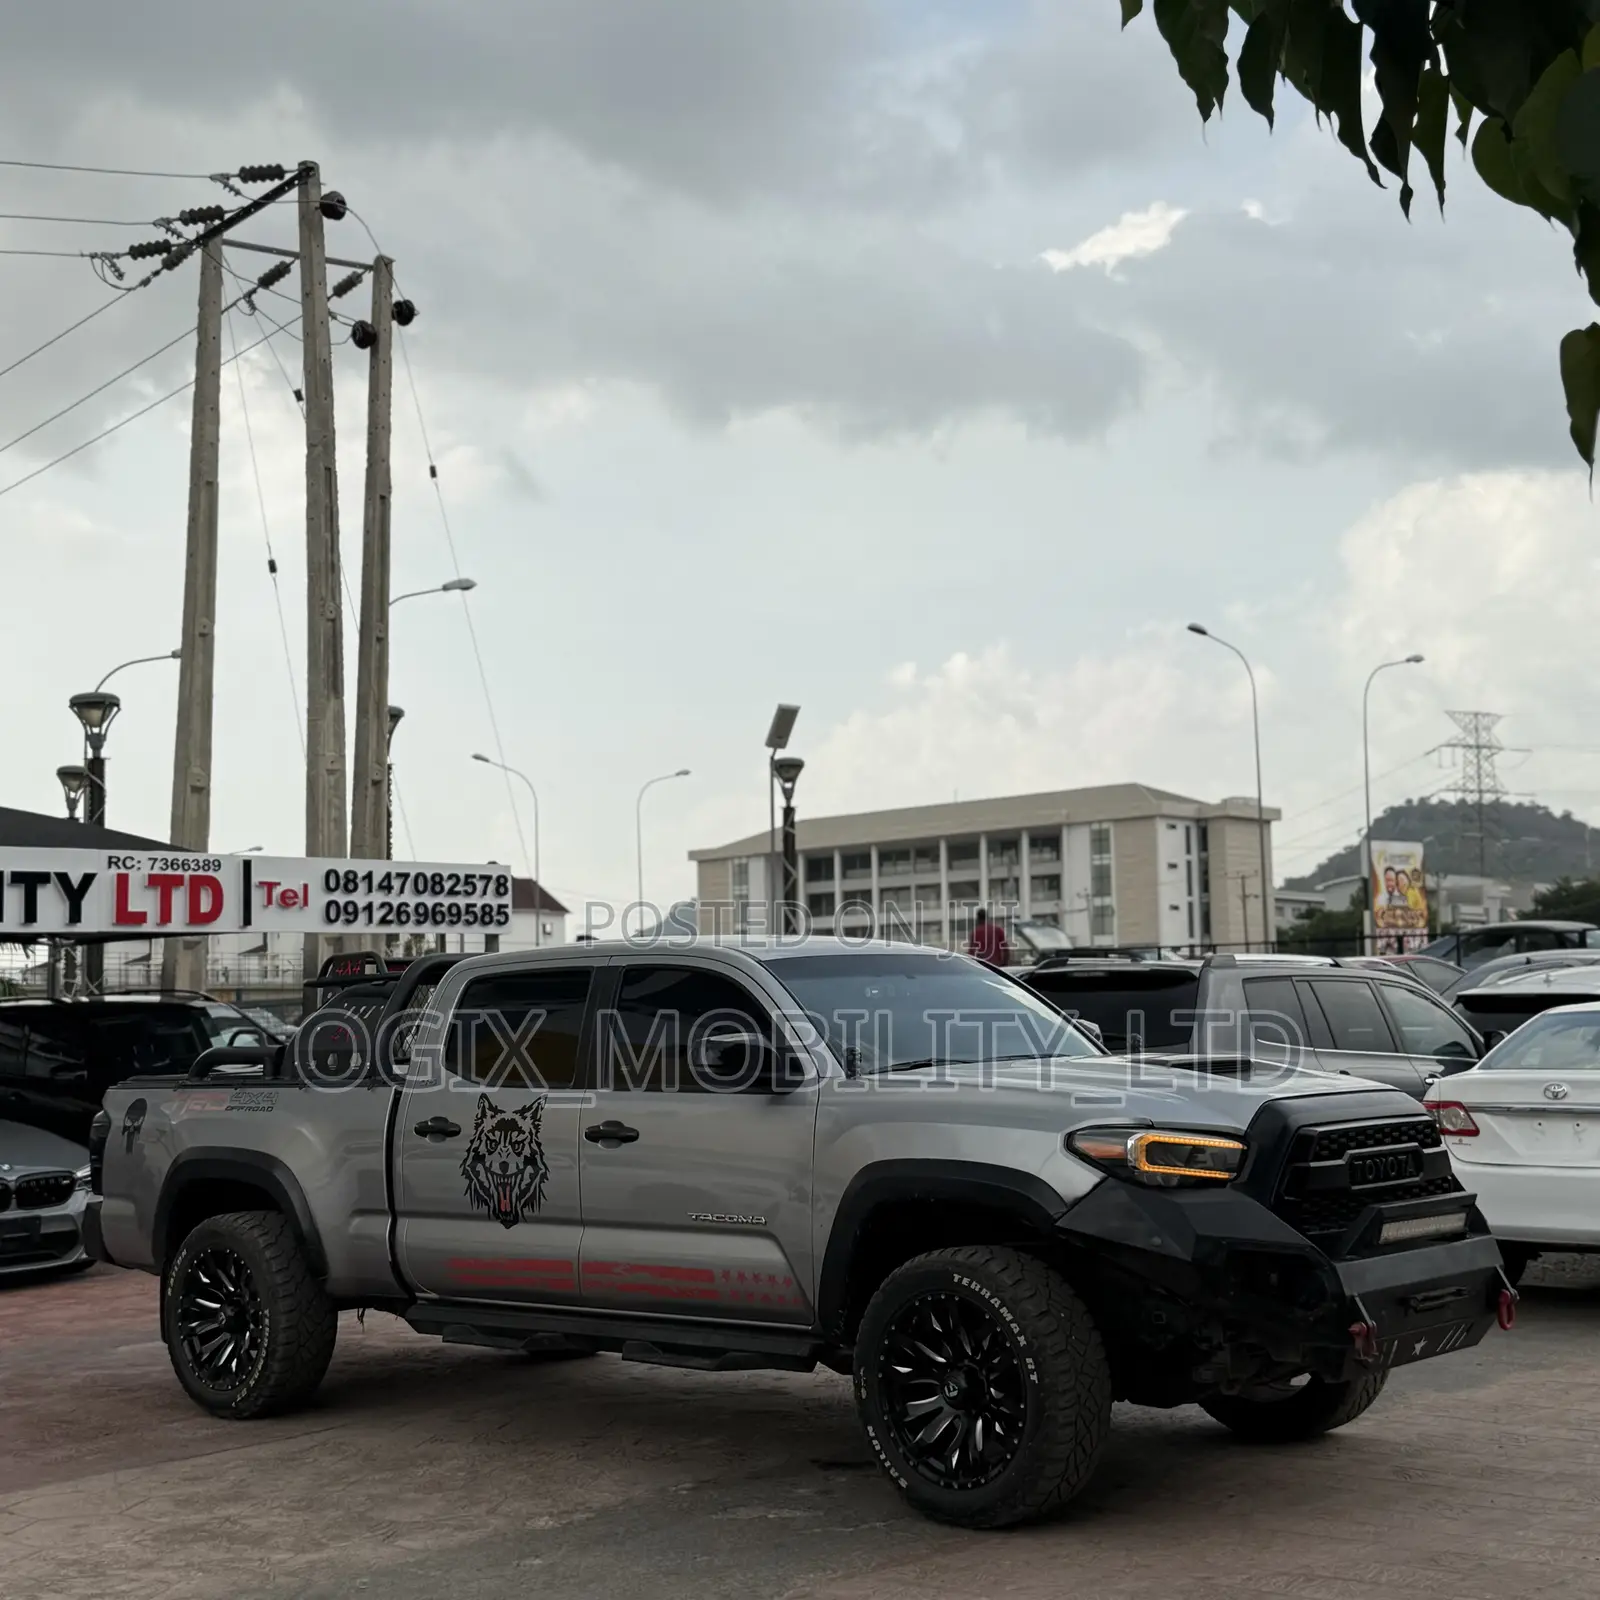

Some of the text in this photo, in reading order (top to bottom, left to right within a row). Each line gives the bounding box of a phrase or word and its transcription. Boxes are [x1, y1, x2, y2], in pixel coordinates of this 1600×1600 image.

[107, 855, 222, 872] RC: 7366389
[256, 880, 309, 908] Tel
[324, 868, 509, 897] 08147082578
[0, 870, 225, 926] TY LTD
[324, 899, 510, 926] 09126969585
[1352, 1153, 1418, 1181] TOYOTA
[687, 1212, 768, 1226] TACOMA
[952, 1272, 1028, 1348] TERRAMAX
